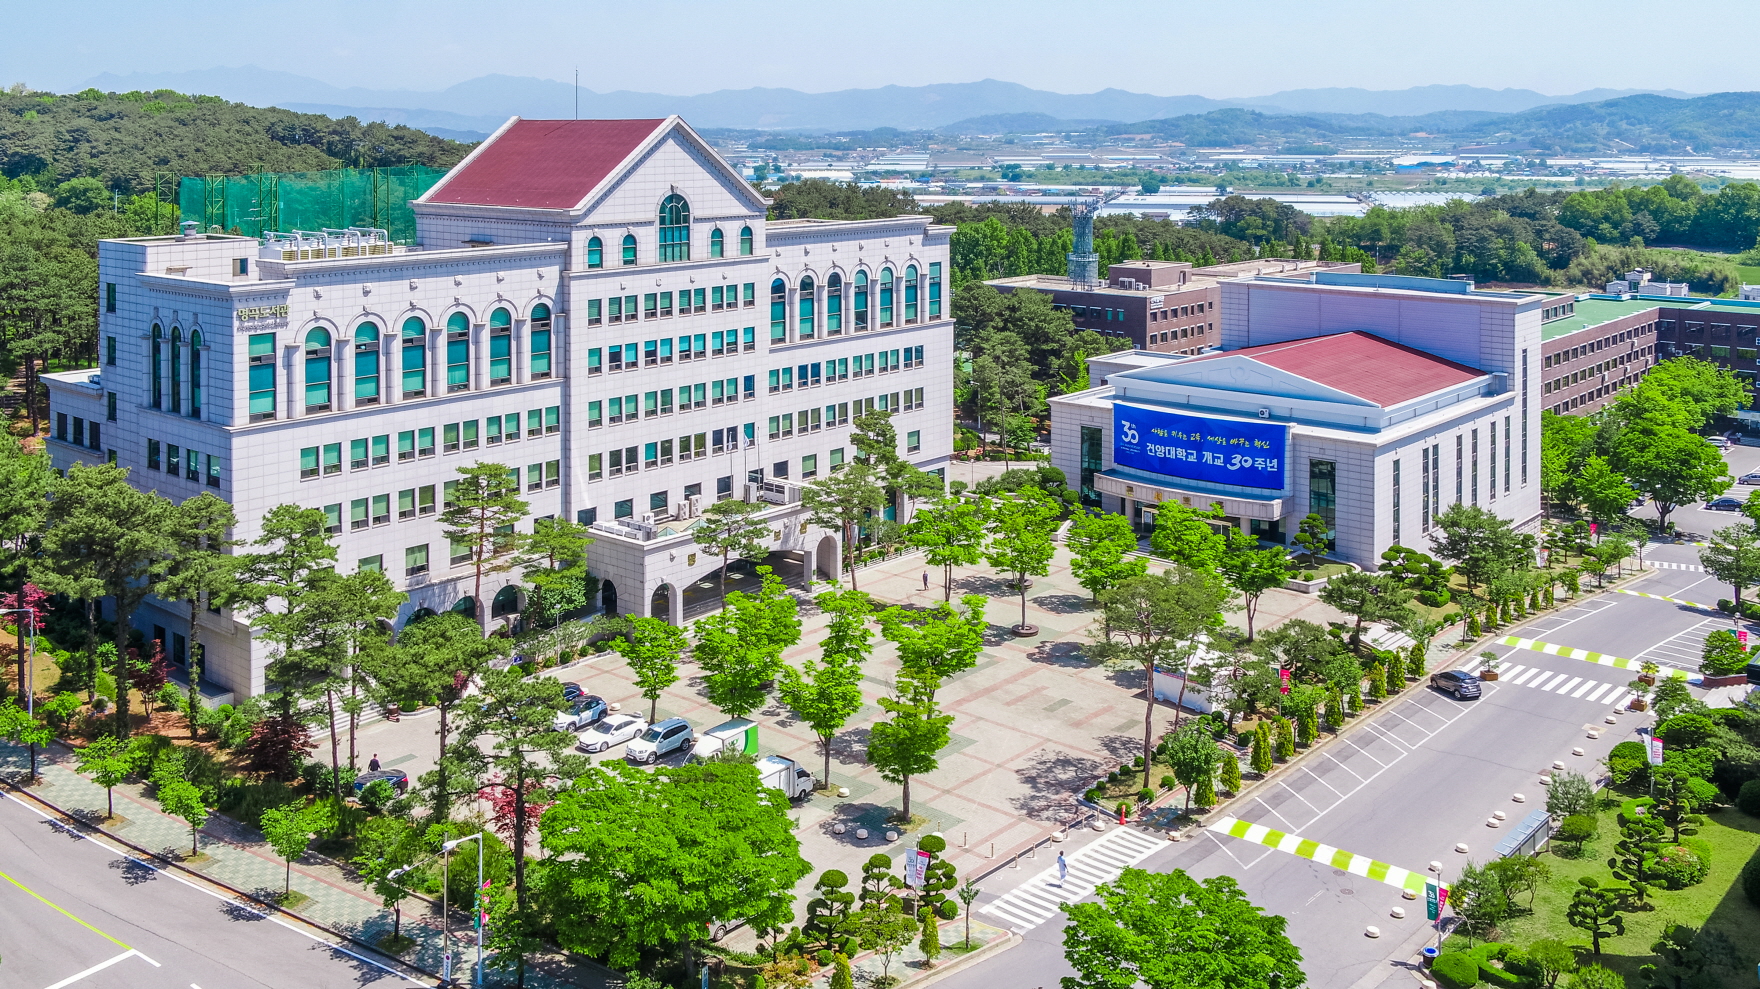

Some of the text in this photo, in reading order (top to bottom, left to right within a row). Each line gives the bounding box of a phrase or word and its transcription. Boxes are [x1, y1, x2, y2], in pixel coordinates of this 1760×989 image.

[238, 304, 290, 321] 명곡도서관
[1151, 427, 1270, 449] 사람을 키우는 교육, 세상을 바꾸는 혁신
[1146, 442, 1197, 462] 건양대학교
[1202, 451, 1224, 466] 개교
